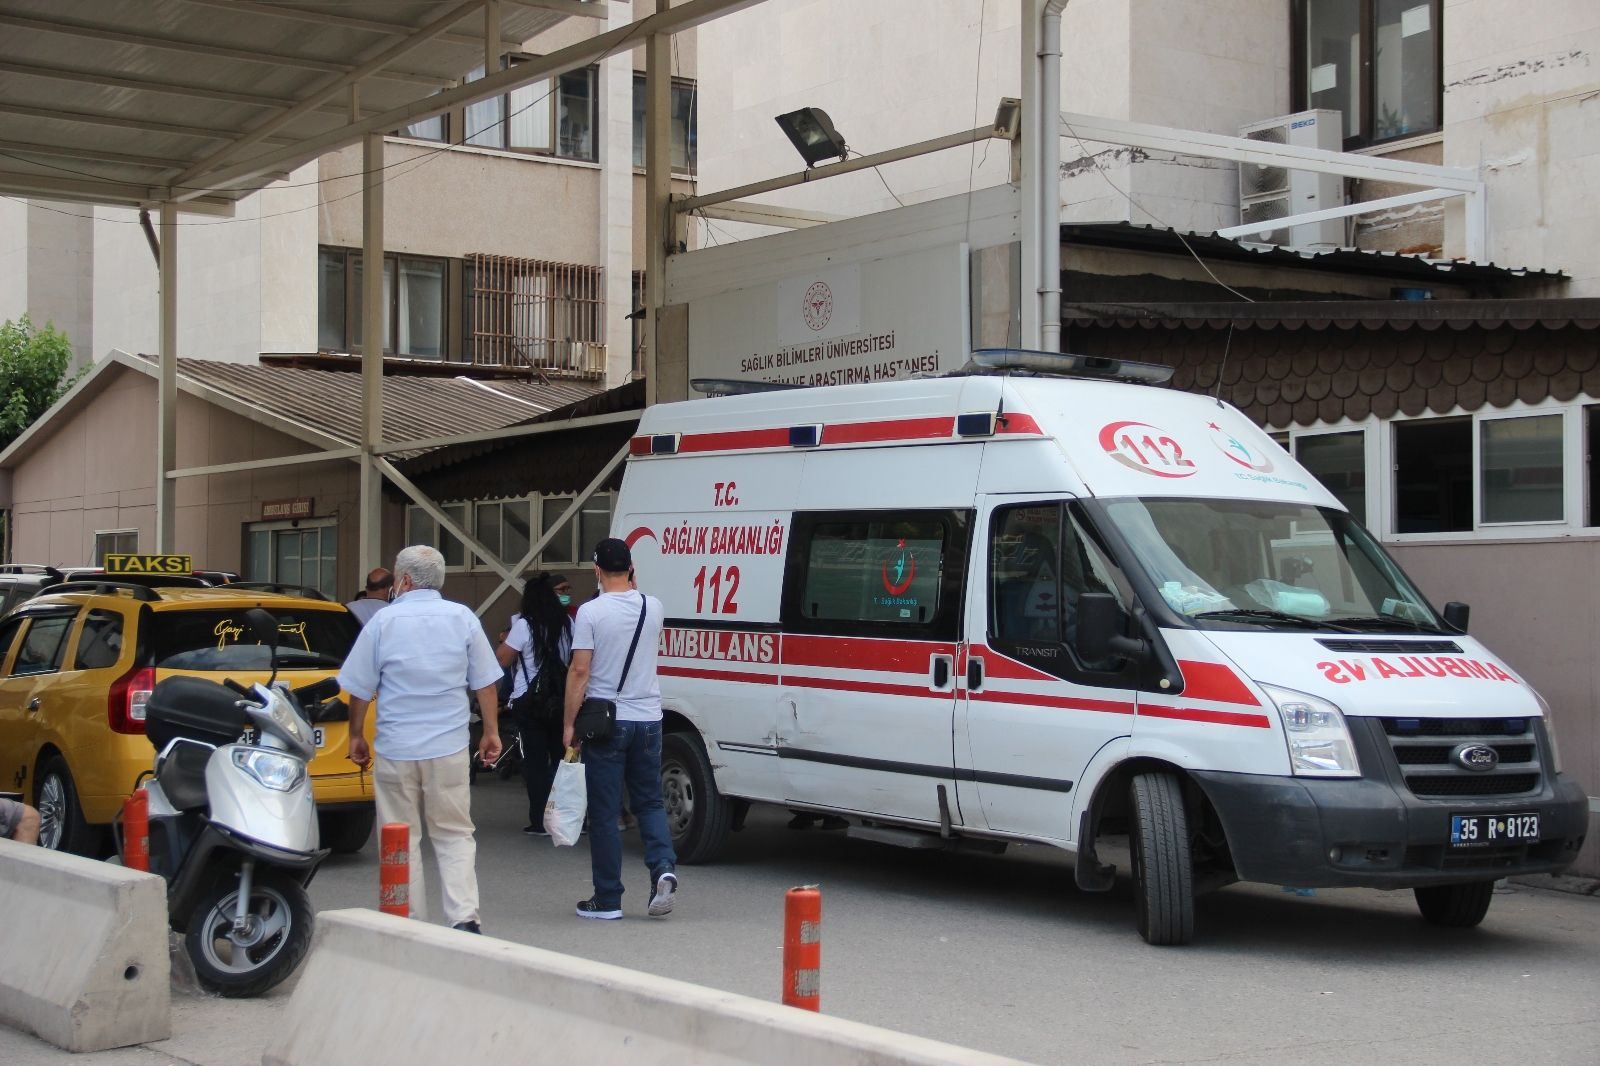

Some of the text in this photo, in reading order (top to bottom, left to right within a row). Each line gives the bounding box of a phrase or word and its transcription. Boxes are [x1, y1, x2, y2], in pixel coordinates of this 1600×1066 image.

[1291, 118, 1315, 130] BEKO
[741, 330, 895, 373] SAĞLIK BİLİMLERİ ÜNİVERSİTESİ
[874, 350, 939, 380] HASTANESİ
[1120, 434, 1196, 467] 112
[714, 481, 739, 507] T.C.
[263, 503, 291, 516] AMBULANS
[661, 518, 784, 555] SAĞLIK BAKANLIĞI
[693, 565, 740, 614] 112
[658, 628, 774, 662] AMBULANS
[1015, 646, 1059, 658] TRANSIT
[1471, 749, 1492, 763] Ford
[1460, 816, 1538, 840] 35 R 8123
